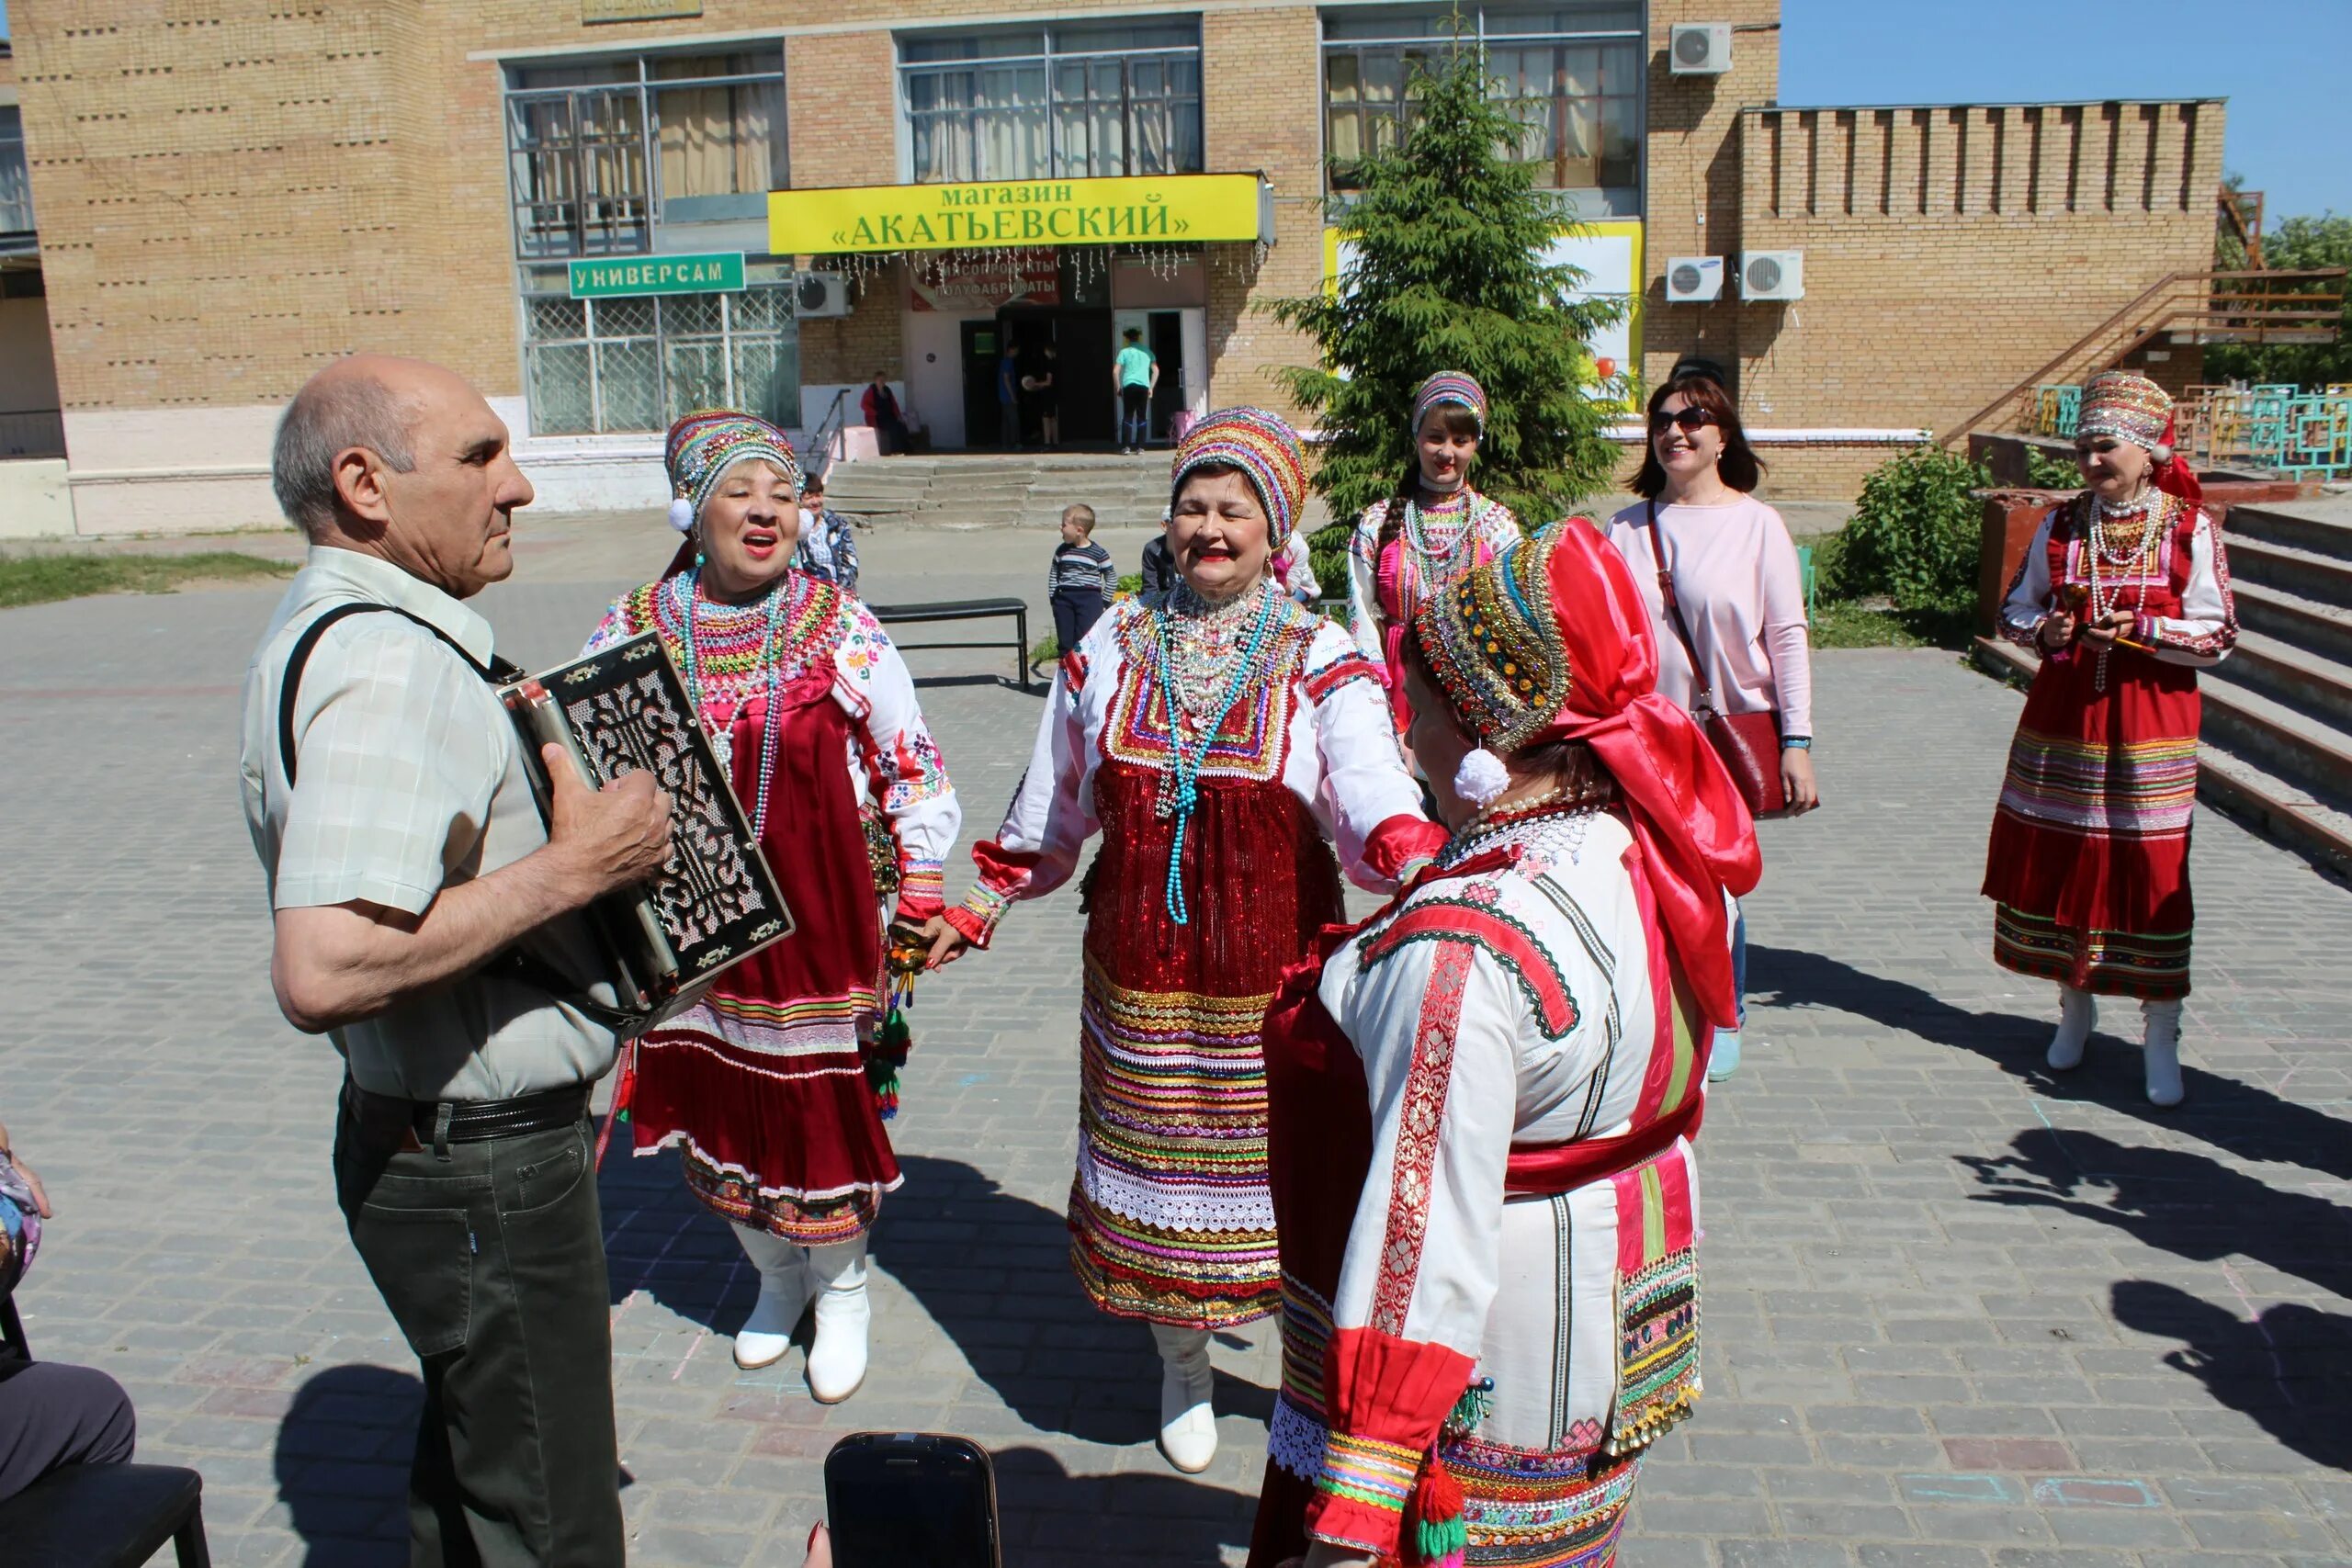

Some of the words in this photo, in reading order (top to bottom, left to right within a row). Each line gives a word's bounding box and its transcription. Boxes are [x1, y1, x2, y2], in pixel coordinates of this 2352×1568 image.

[942, 185, 1071, 207] магазин
[832, 193, 1189, 245] «АКАТЬЕВСКИЙ»
[576, 263, 722, 288] УНИВЕРСАМ
